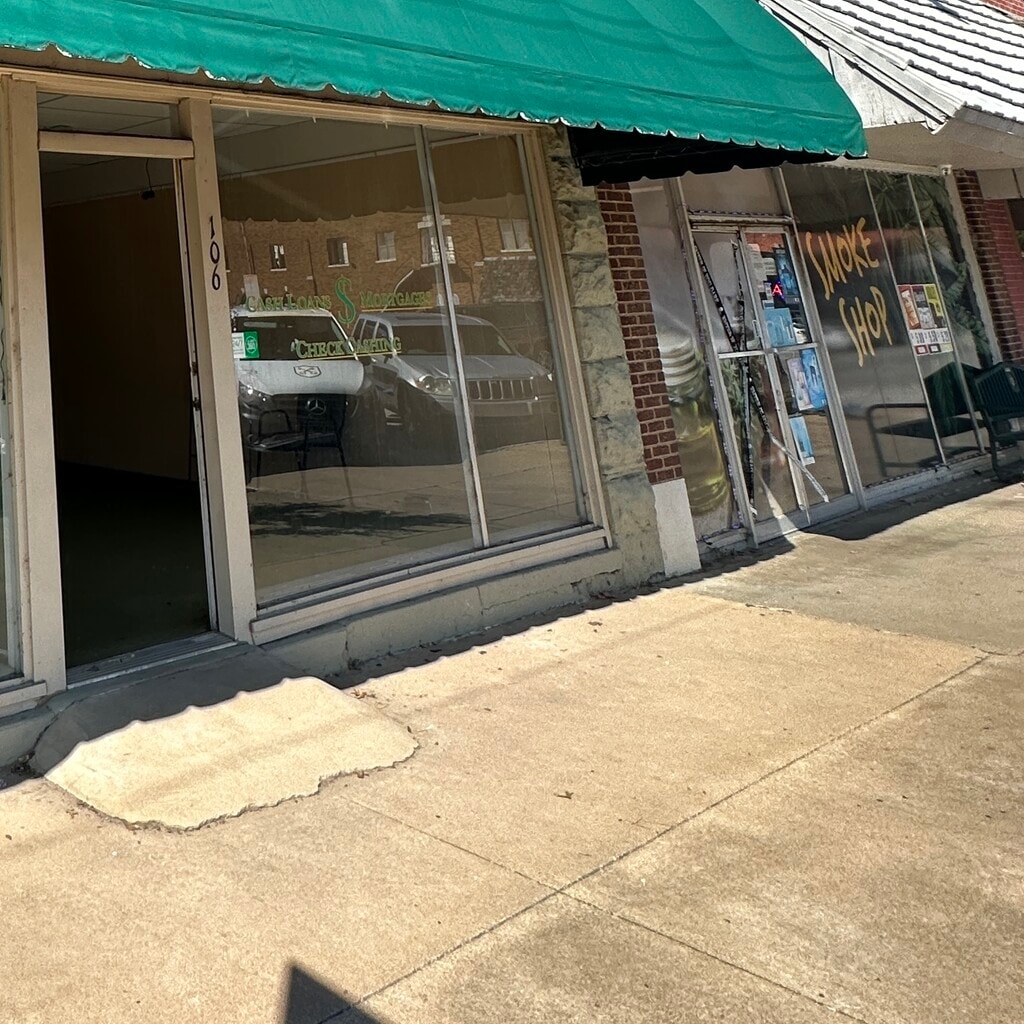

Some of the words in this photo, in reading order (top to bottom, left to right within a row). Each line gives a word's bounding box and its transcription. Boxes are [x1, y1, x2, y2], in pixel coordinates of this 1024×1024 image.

[208, 215, 221, 291] 106
[805, 216, 880, 301] SMOKE
[246, 295, 284, 312] CASH
[285, 293, 332, 311] LOANS
[359, 290, 433, 308] MORTGAGES
[838, 285, 893, 367] SHOP
[295, 339, 346, 359] CHECK
[345, 336, 403, 355] CASHING
